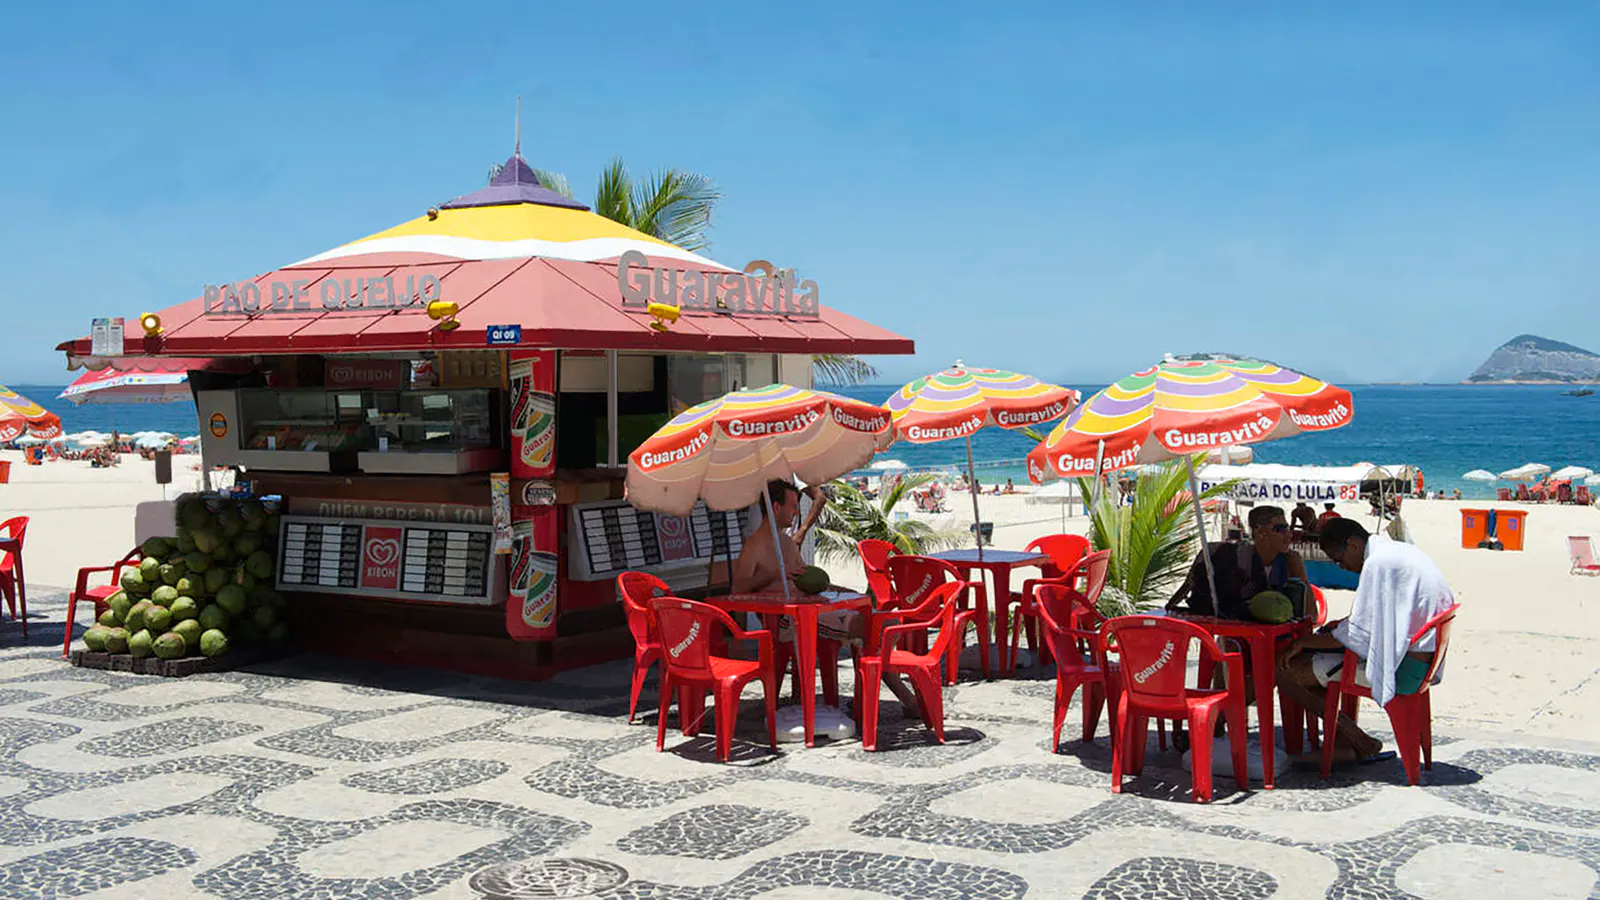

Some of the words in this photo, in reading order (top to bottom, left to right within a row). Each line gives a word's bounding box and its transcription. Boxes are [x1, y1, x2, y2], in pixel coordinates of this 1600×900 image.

[271, 279, 309, 309] DE
[321, 274, 441, 310] QUEIJO
[618, 250, 819, 313] Guaravita
[729, 408, 819, 436] Guaravita
[834, 407, 887, 431] Guaravita
[909, 416, 982, 439] Guaravita
[998, 402, 1063, 425] Guaravita
[1290, 402, 1348, 427] Guaravita
[1165, 413, 1273, 448] Guaravita
[641, 430, 709, 468] Guaravita
[1058, 442, 1142, 472] Guaavita
[1273, 484, 1292, 499] DO
[1297, 485, 1335, 500] LULA
[1340, 485, 1357, 500] 85
[366, 566, 396, 578] KIBON
[1134, 640, 1175, 684] Guaravita
